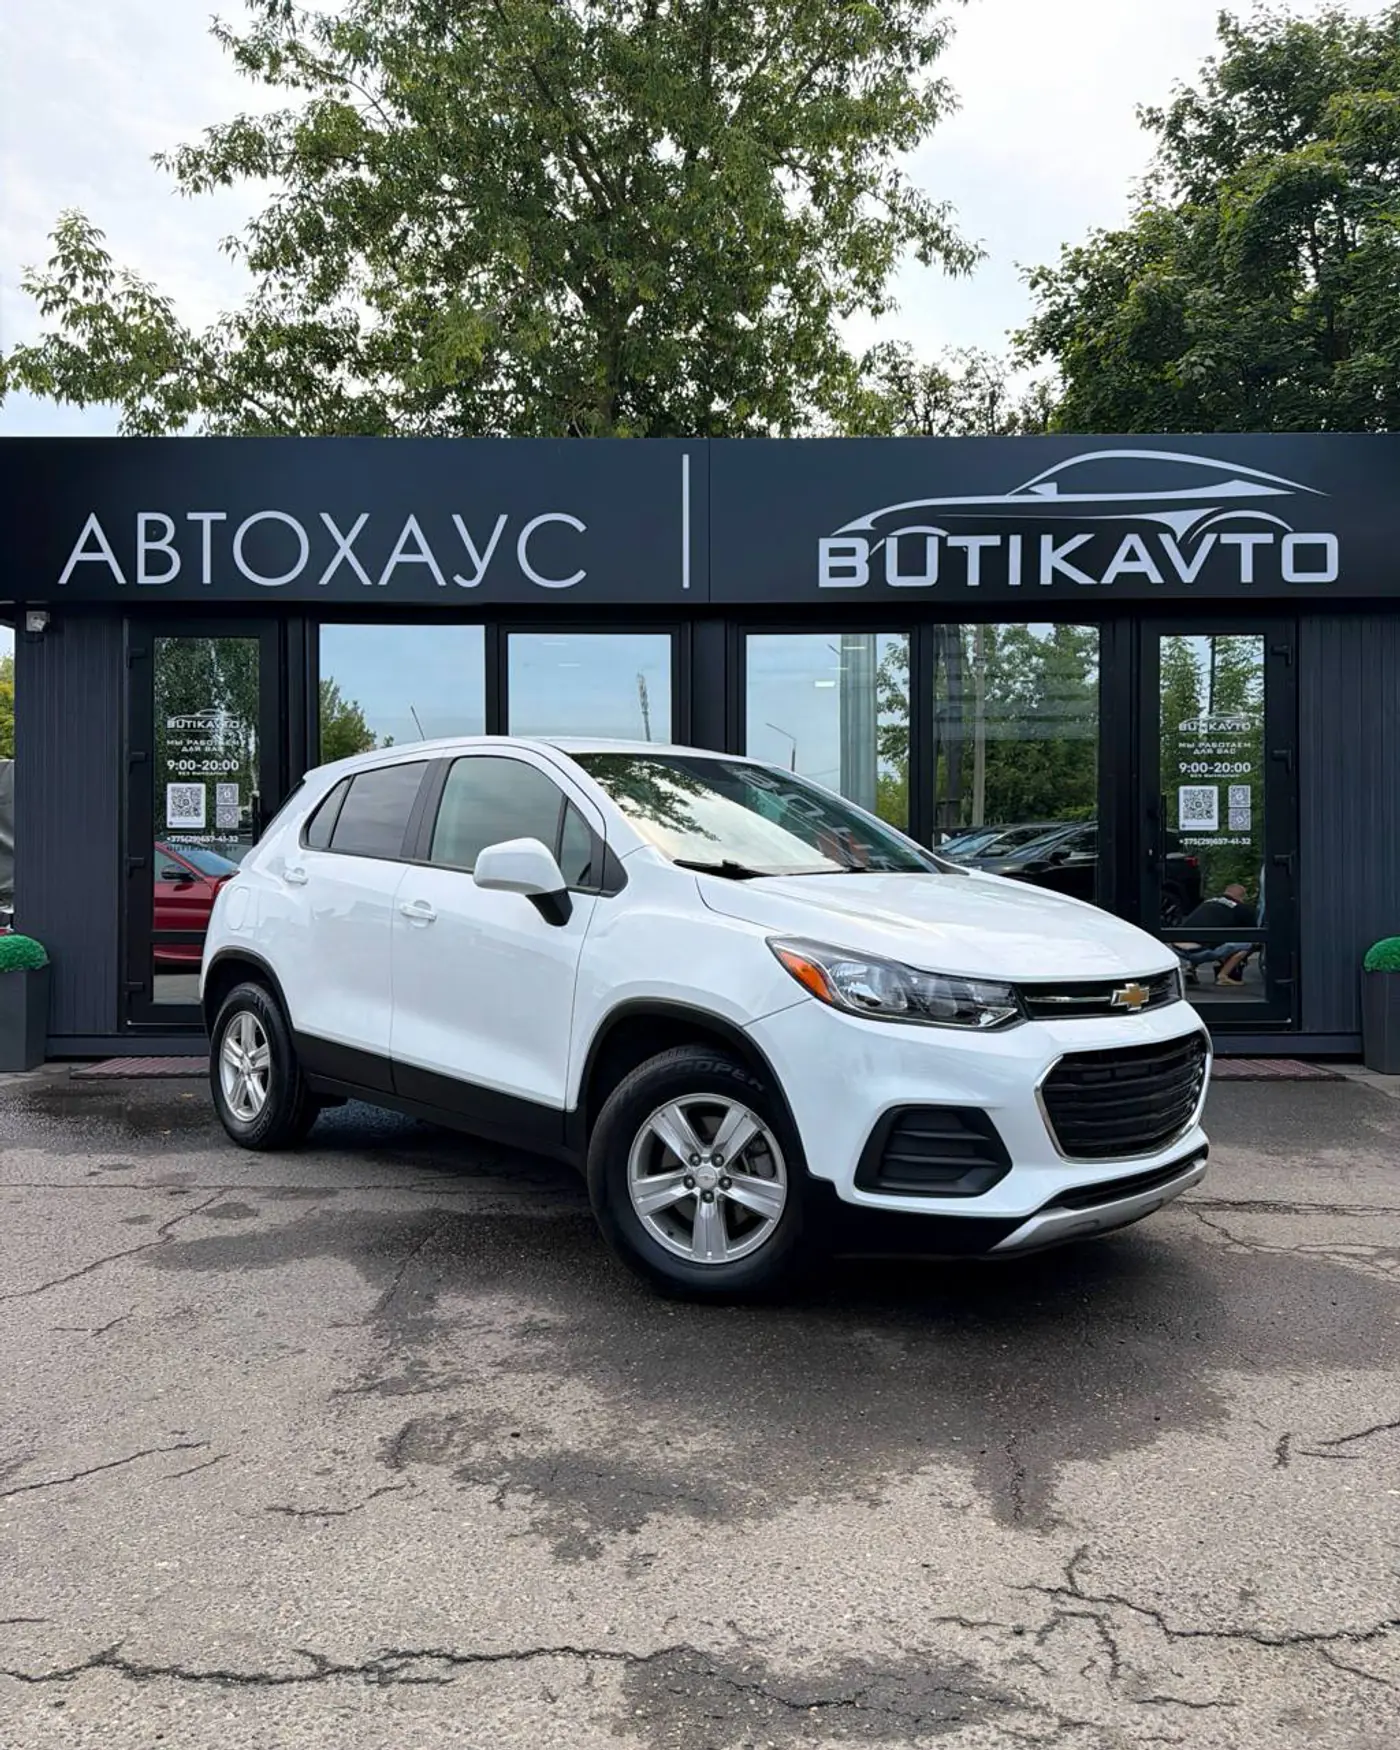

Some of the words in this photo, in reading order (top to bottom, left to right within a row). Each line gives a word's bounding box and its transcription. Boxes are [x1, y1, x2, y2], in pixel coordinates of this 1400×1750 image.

[58, 510, 587, 588] АВТОХАУС
[818, 533, 1339, 588] BUTIKAVTO
[1179, 722, 1252, 732] BUKAVTO
[167, 760, 240, 771] 9:00-20:00
[1179, 762, 1252, 773] 9:00-20:00
